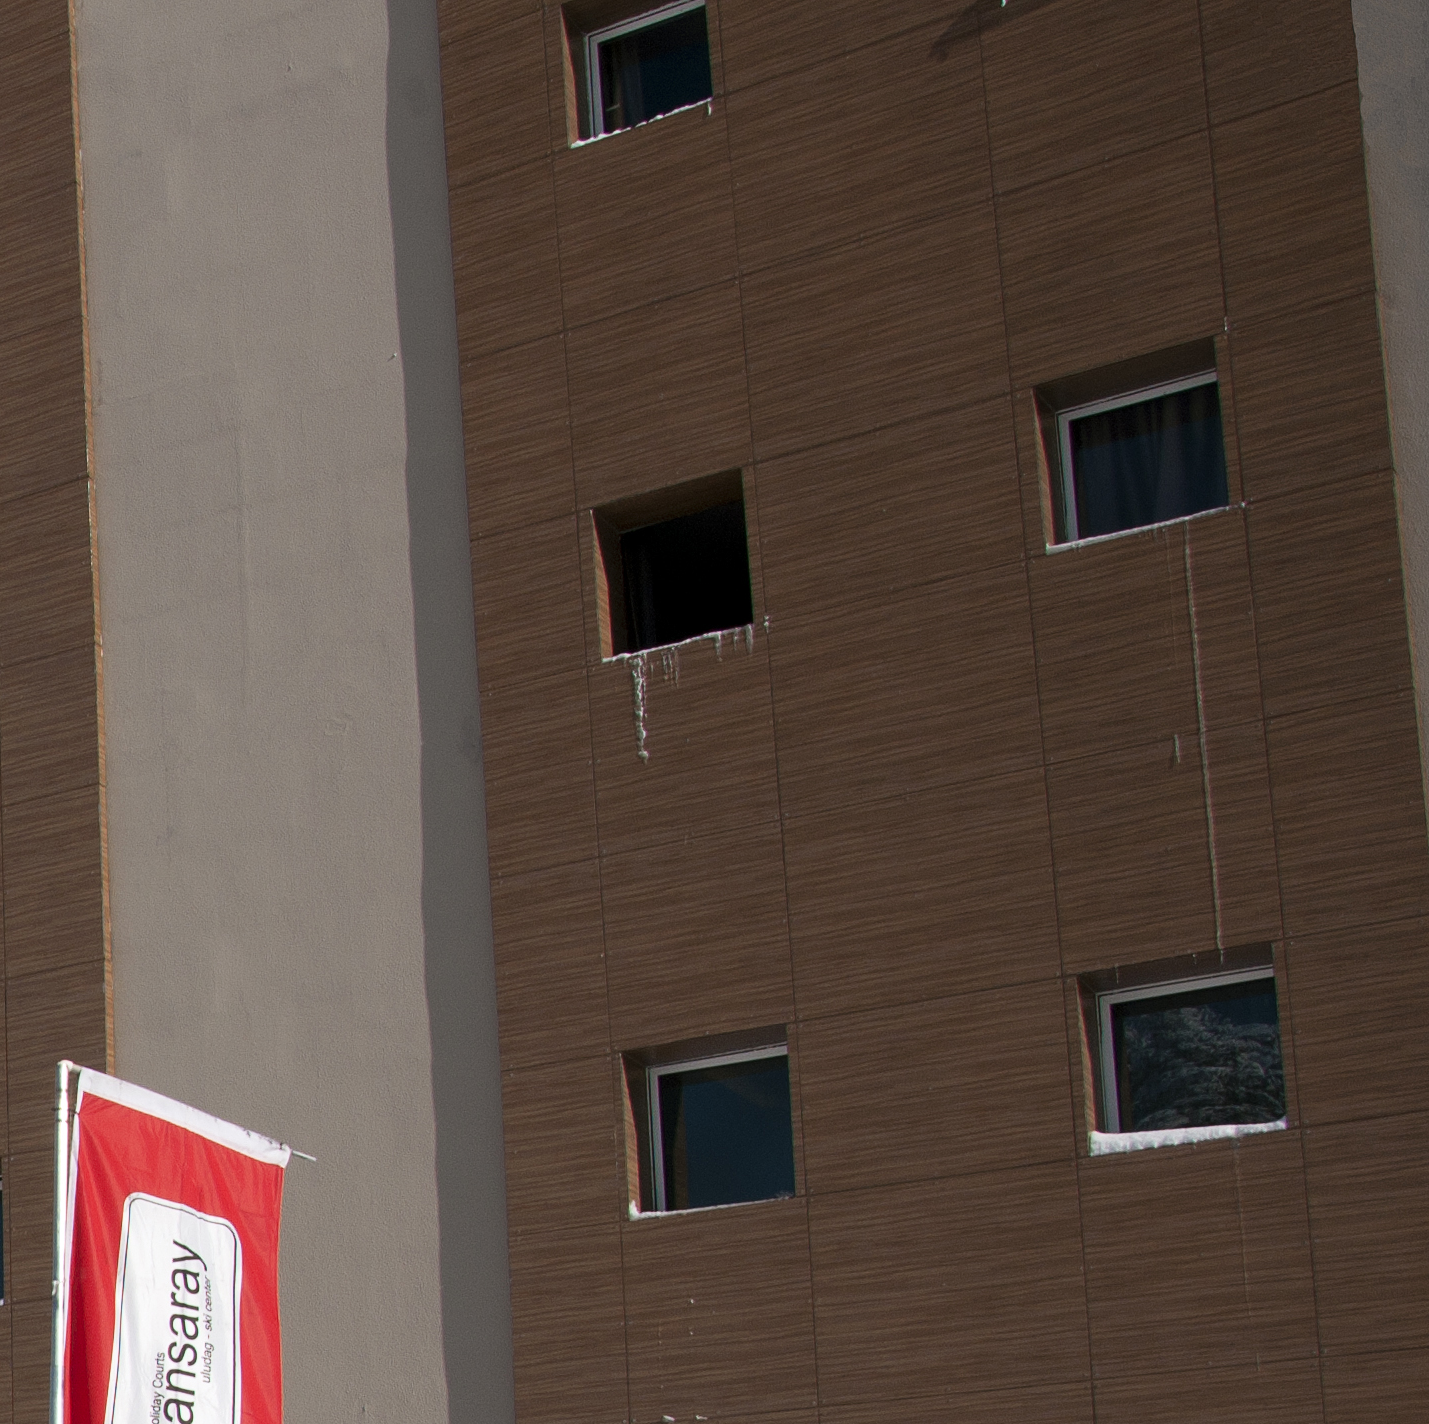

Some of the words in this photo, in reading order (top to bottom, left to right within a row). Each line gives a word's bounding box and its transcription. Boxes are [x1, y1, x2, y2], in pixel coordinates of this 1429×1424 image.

[205, 1275, 213, 1312] center
[202, 1312, 213, 1332] ski
[152, 1352, 166, 1389] Courts
[200, 1342, 215, 1384] uludag
